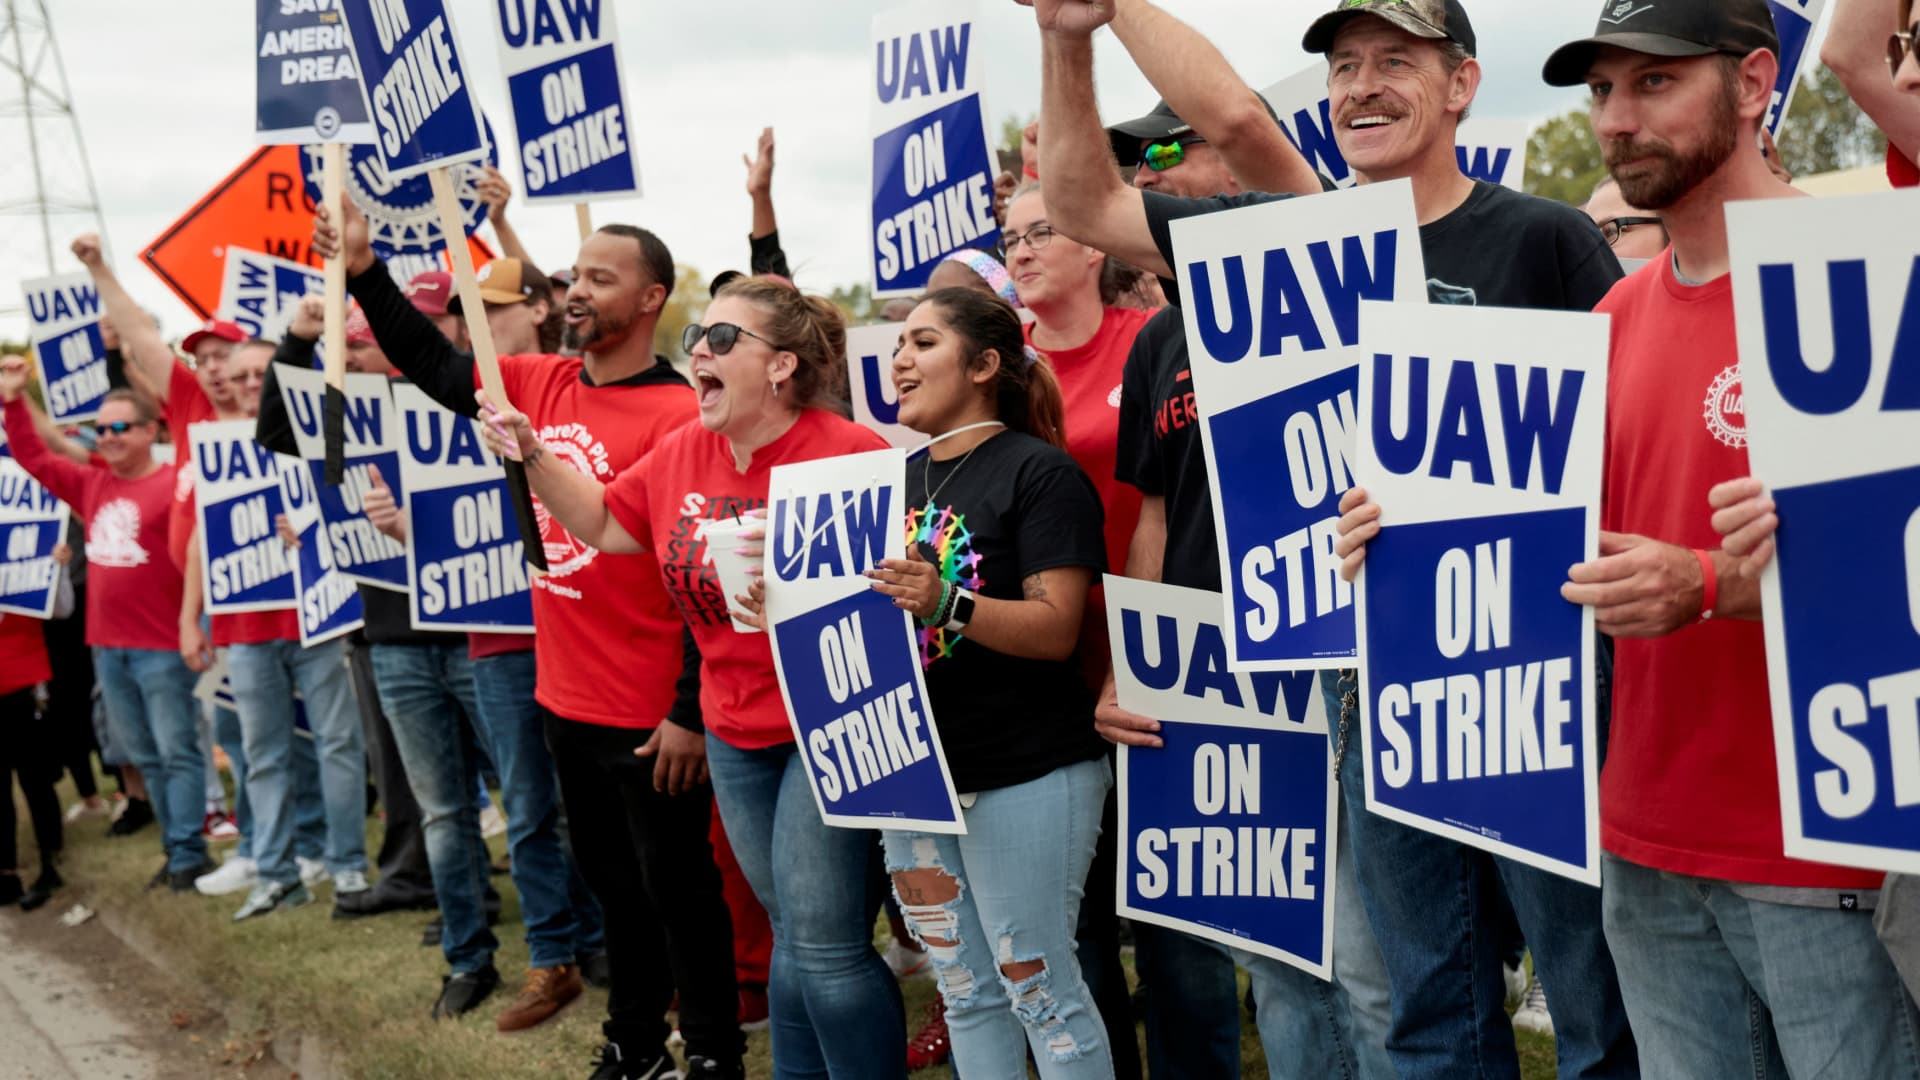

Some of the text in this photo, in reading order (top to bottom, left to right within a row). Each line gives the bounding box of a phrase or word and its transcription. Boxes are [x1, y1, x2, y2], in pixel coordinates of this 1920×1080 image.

[259, 23, 352, 57] AMERI
[497, 0, 601, 48] UAW
[876, 22, 972, 104] UAW
[373, 15, 462, 158] STRIKE
[541, 62, 586, 125] ON
[523, 104, 627, 191] STRIKE
[903, 119, 948, 197] ON
[876, 171, 996, 281] STRIKE
[27, 285, 100, 323] UAW
[1188, 228, 1398, 364] UAW
[59, 329, 94, 372] ON
[288, 387, 383, 446] UW
[405, 394, 504, 467] UA
[1283, 389, 1358, 509] ON
[1371, 353, 1586, 496] UAW
[7, 523, 41, 562] ON
[230, 494, 271, 547] ON
[452, 488, 504, 551] ON
[773, 484, 892, 582] UAW
[1435, 537, 1512, 659] ON
[819, 610, 873, 704] ON
[1121, 608, 1317, 724] UAW
[809, 682, 931, 803] STRIKE
[1378, 656, 1574, 789] STRIKE
[1193, 743, 1261, 816] ON
[1136, 827, 1316, 900] STRIKE
